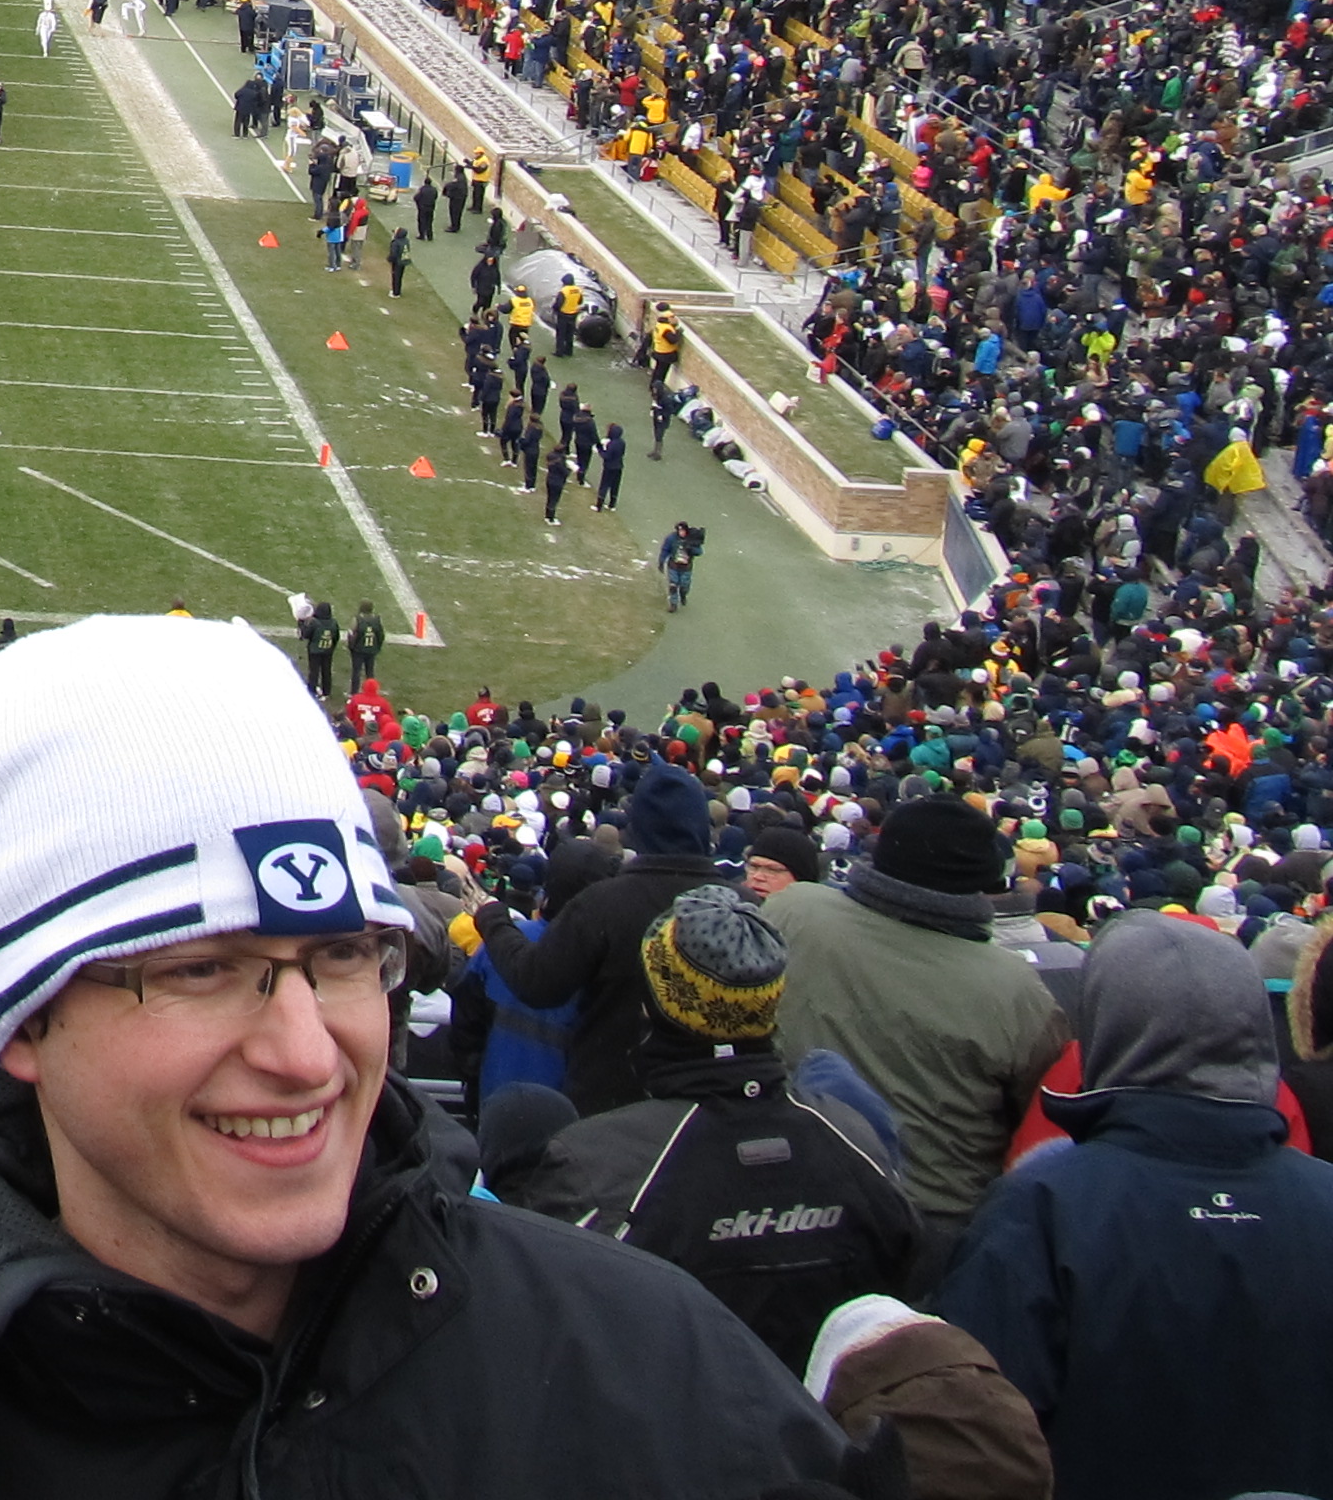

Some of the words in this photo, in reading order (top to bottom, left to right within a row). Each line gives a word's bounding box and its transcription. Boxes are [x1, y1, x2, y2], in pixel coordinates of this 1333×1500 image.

[271, 852, 329, 902] Y
[708, 1203, 844, 1241] ski-doo
[1189, 1206, 1261, 1224] Champion
